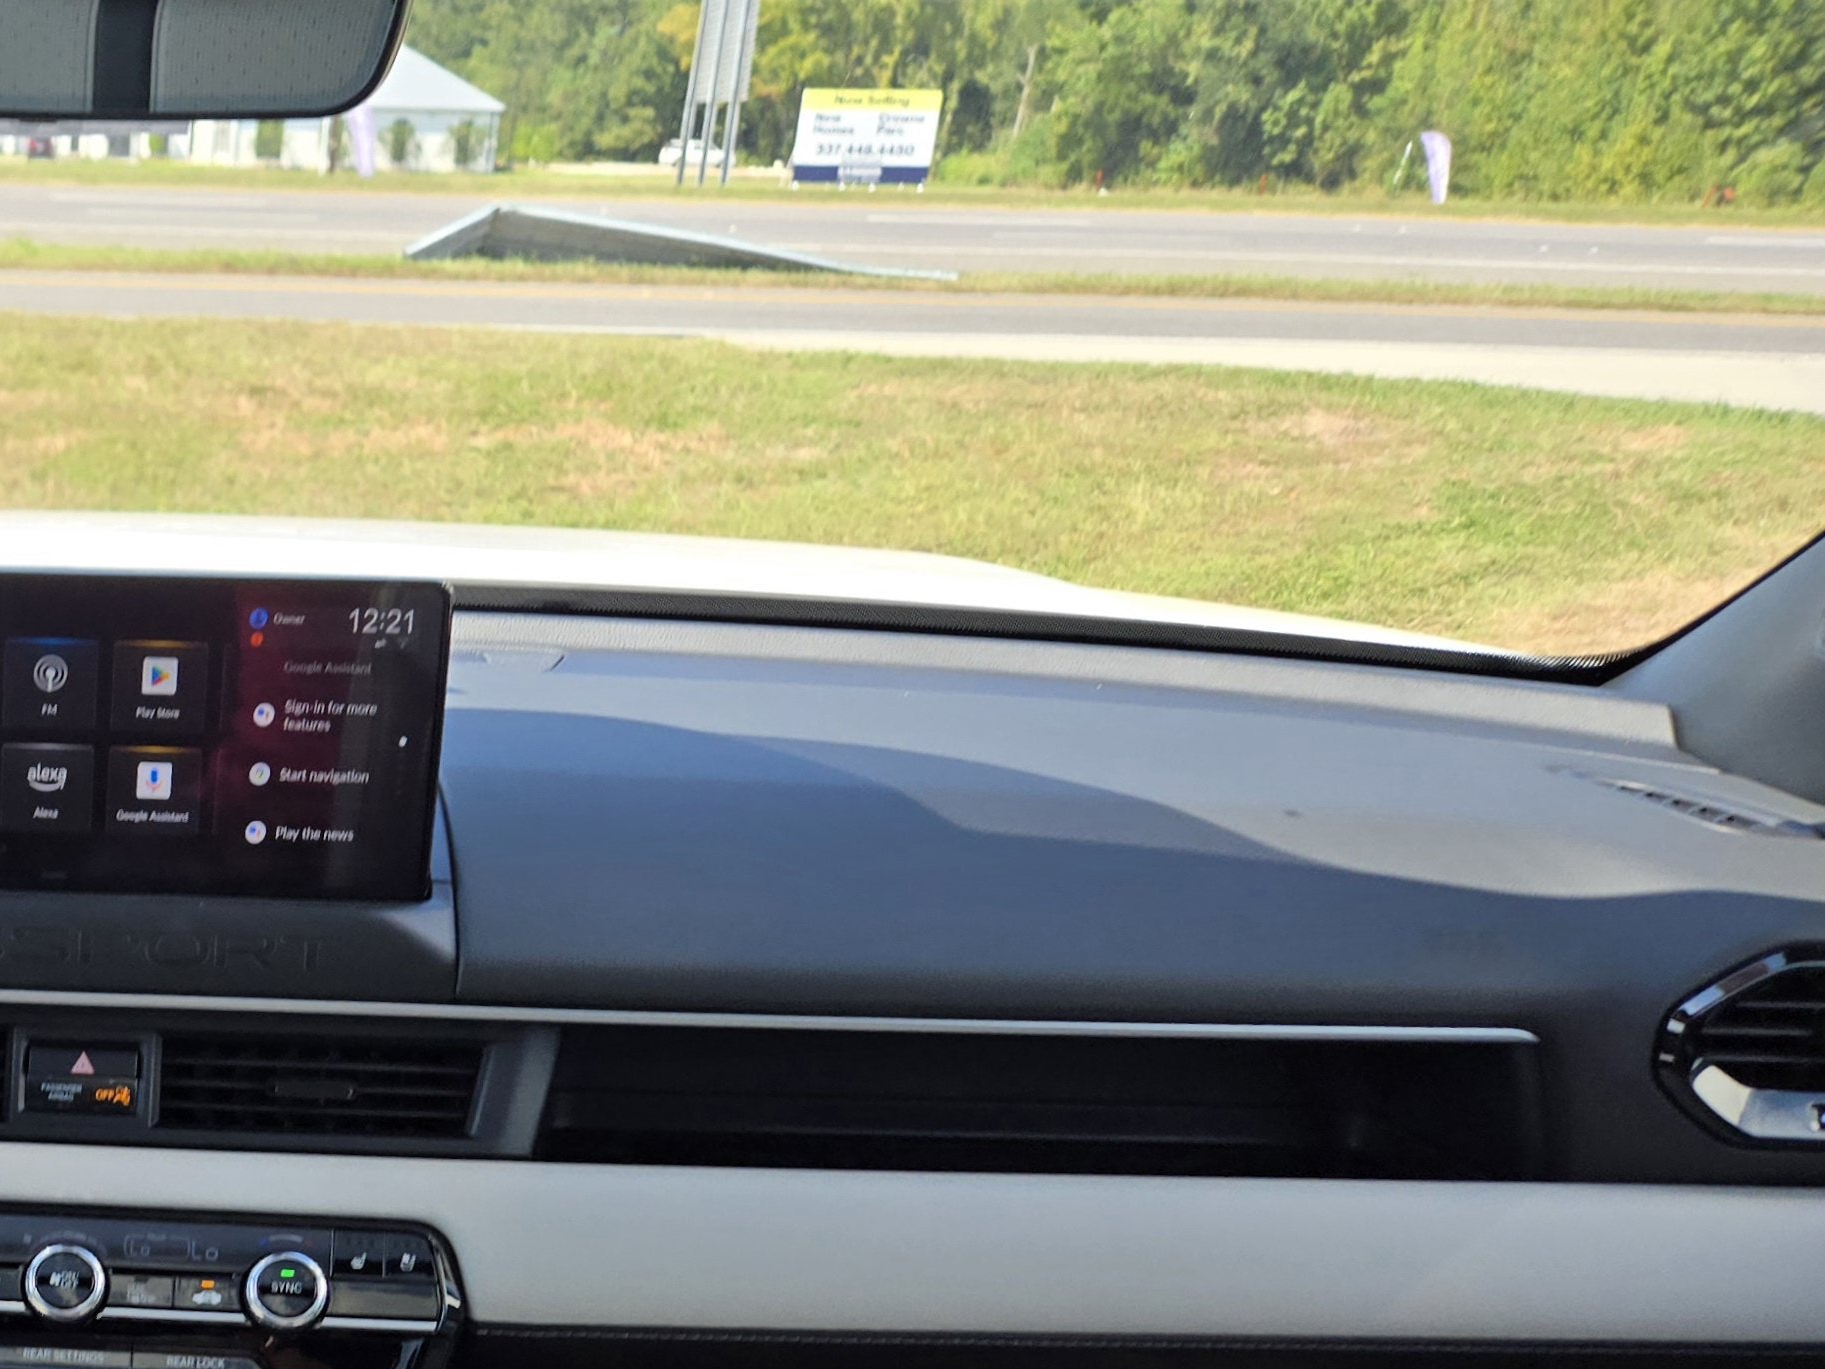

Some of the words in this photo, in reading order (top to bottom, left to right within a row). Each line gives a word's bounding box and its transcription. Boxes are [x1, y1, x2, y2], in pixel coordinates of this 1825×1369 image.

[349, 607, 415, 635] 12:21
[283, 661, 323, 675] Google
[325, 661, 372, 676] Assistant
[41, 703, 58, 716] FM
[135, 706, 156, 720] Play
[157, 707, 181, 720] Store
[284, 698, 325, 717] Sign-in
[327, 699, 345, 715] for
[346, 702, 378, 716] more
[283, 716, 332, 733] features
[279, 767, 307, 783] Start
[308, 768, 370, 786] navigation
[33, 806, 59, 820] Alexa
[115, 808, 149, 823] Google
[149, 809, 189, 824] Assistant
[275, 825, 300, 843] Play
[302, 826, 321, 841] the
[323, 829, 355, 843] news
[270, 1281, 303, 1295] SYNC
[22, 1346, 52, 1360] REAR
[166, 1355, 197, 1369] REAR
